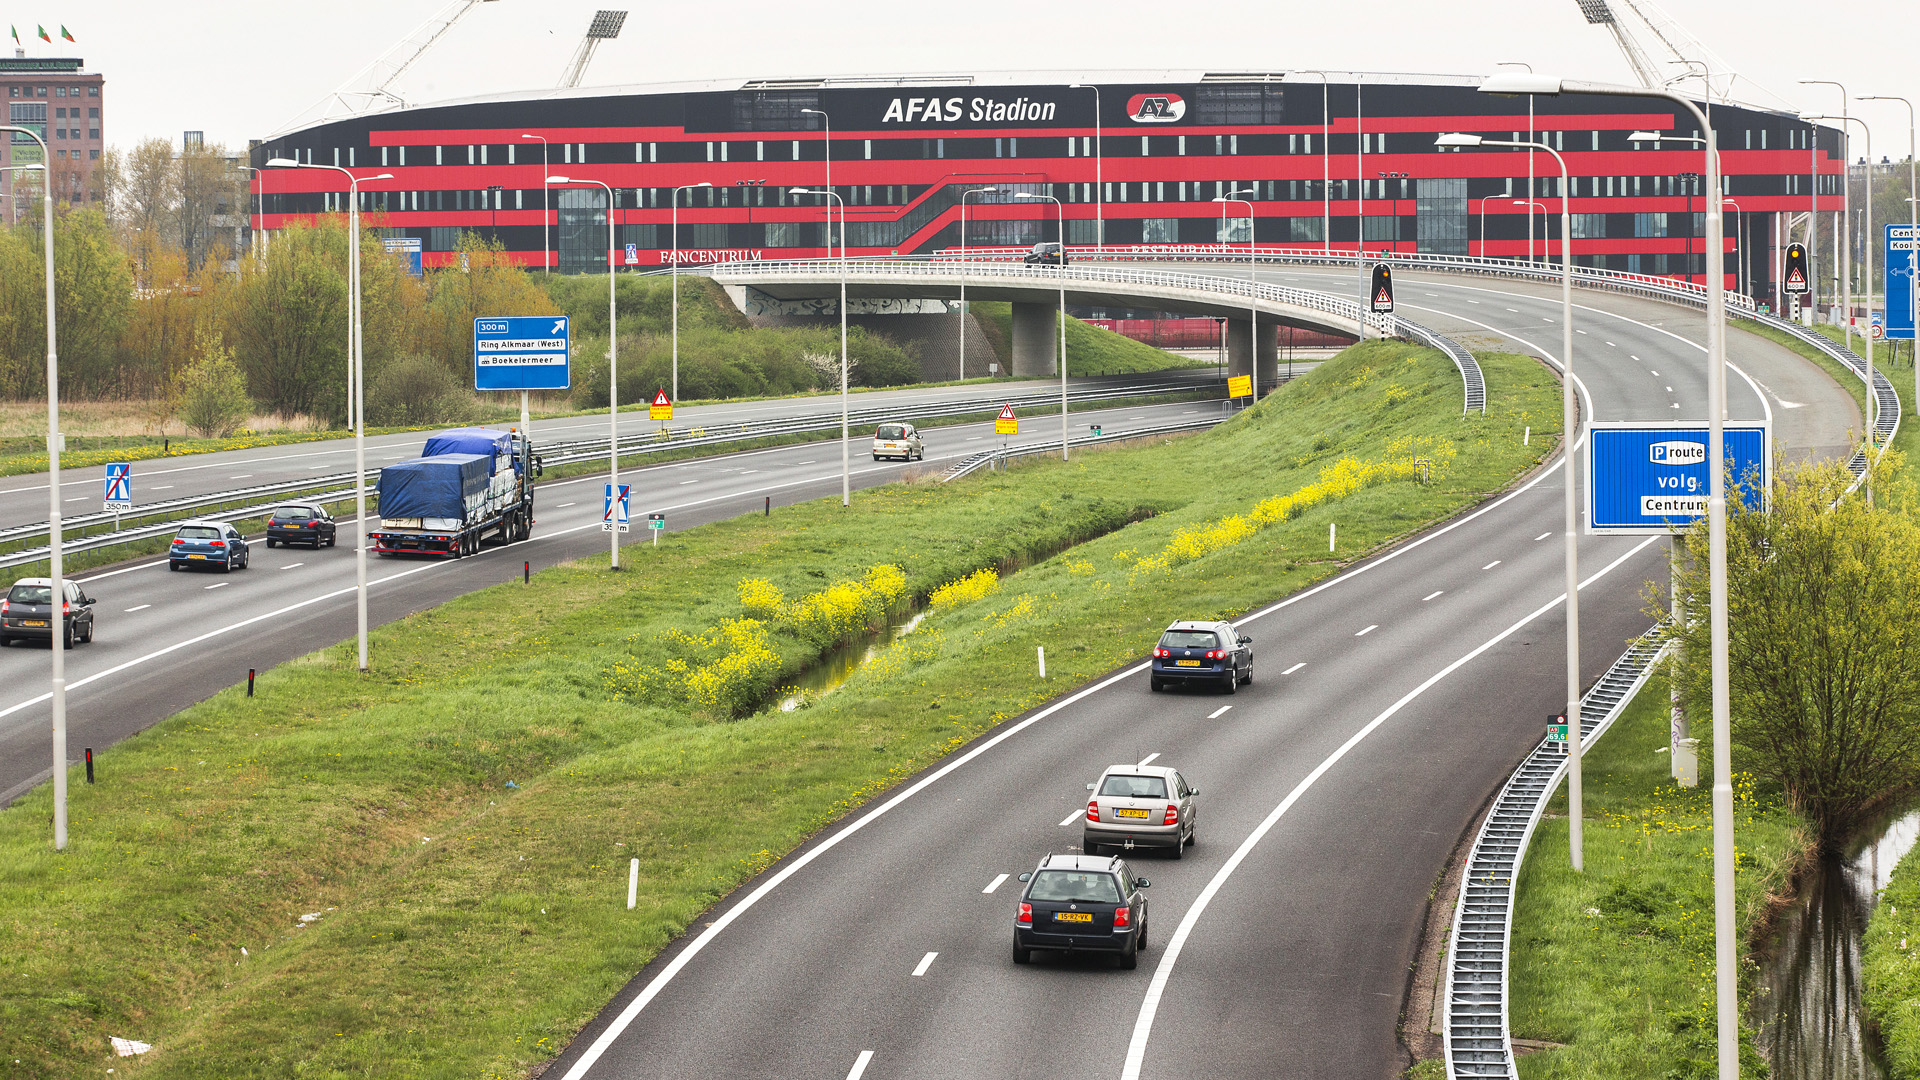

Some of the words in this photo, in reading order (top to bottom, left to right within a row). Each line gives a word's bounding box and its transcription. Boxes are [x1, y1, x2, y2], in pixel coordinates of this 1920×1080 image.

[881, 98, 963, 122] AFAS
[969, 97, 1056, 122] Stadion
[1136, 97, 1177, 119] AZ
[660, 250, 762, 263] FANCENTRUM
[481, 323, 497, 331] 300
[481, 341, 499, 350] Ring
[501, 340, 535, 348] Alkmaar
[537, 340, 563, 348] (West)
[492, 357, 553, 365] Boekelermeer
[1669, 446, 1703, 457] route
[1657, 473, 1698, 492] volg
[1060, 913, 1089, 921] 15-RZ-VK
